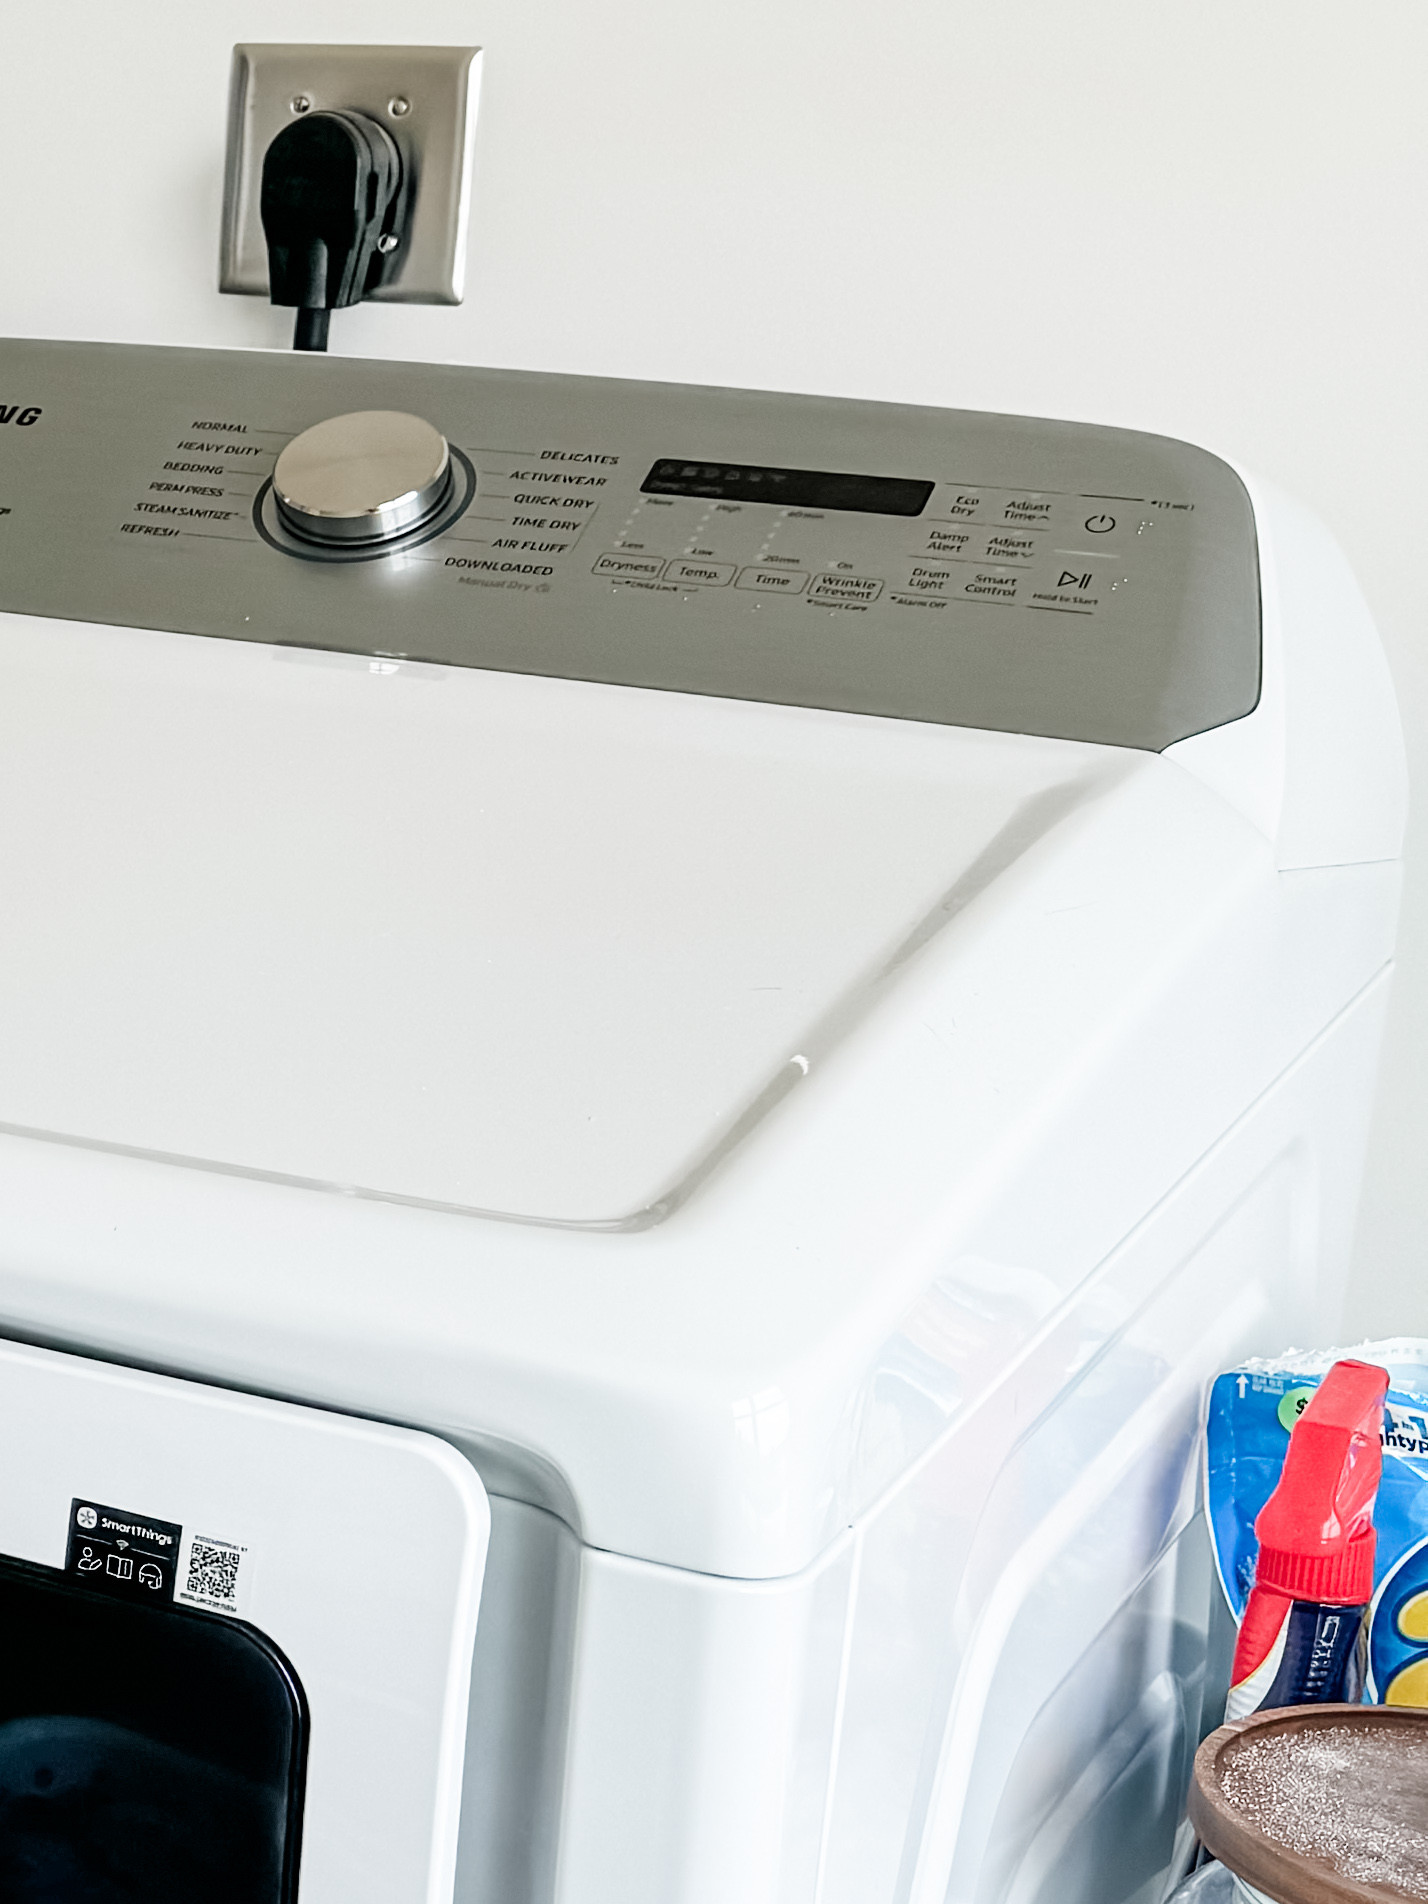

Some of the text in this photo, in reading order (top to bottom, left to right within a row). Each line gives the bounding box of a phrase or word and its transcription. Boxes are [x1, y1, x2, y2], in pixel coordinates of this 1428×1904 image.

[192, 421, 248, 434] NORMAL
[177, 440, 263, 457] HEAVY DUTY
[540, 450, 620, 465] DELICATES
[163, 461, 224, 475] BEDDING
[509, 470, 609, 487] ACTIVEWEAR
[149, 481, 225, 498] PERM PRESS
[514, 493, 595, 510] QUICK DRY
[956, 495, 979, 506] Eco
[1006, 499, 1051, 513] Adjust
[133, 502, 177, 515] STEAM
[950, 505, 975, 517] Dry
[1004, 510, 1036, 521] Time
[120, 523, 180, 537] REFRESH
[512, 516, 581, 532] TIME DRY
[929, 531, 969, 544] Damp
[989, 537, 1033, 550] Adjust
[491, 538, 568, 554] AIR FLUFF
[927, 541, 962, 553] Alert
[986, 547, 1020, 558] Time
[444, 557, 553, 576] DOWNLOADED
[600, 558, 657, 573] Dryness
[755, 574, 791, 586] Time
[912, 567, 950, 580] Drum
[975, 573, 1017, 586] Smart
[822, 576, 877, 590] Wrinkle
[908, 577, 944, 590] Light
[965, 583, 1016, 597] Control
[816, 585, 874, 600] Prevent
[101, 1517, 173, 1546] SmartThings
